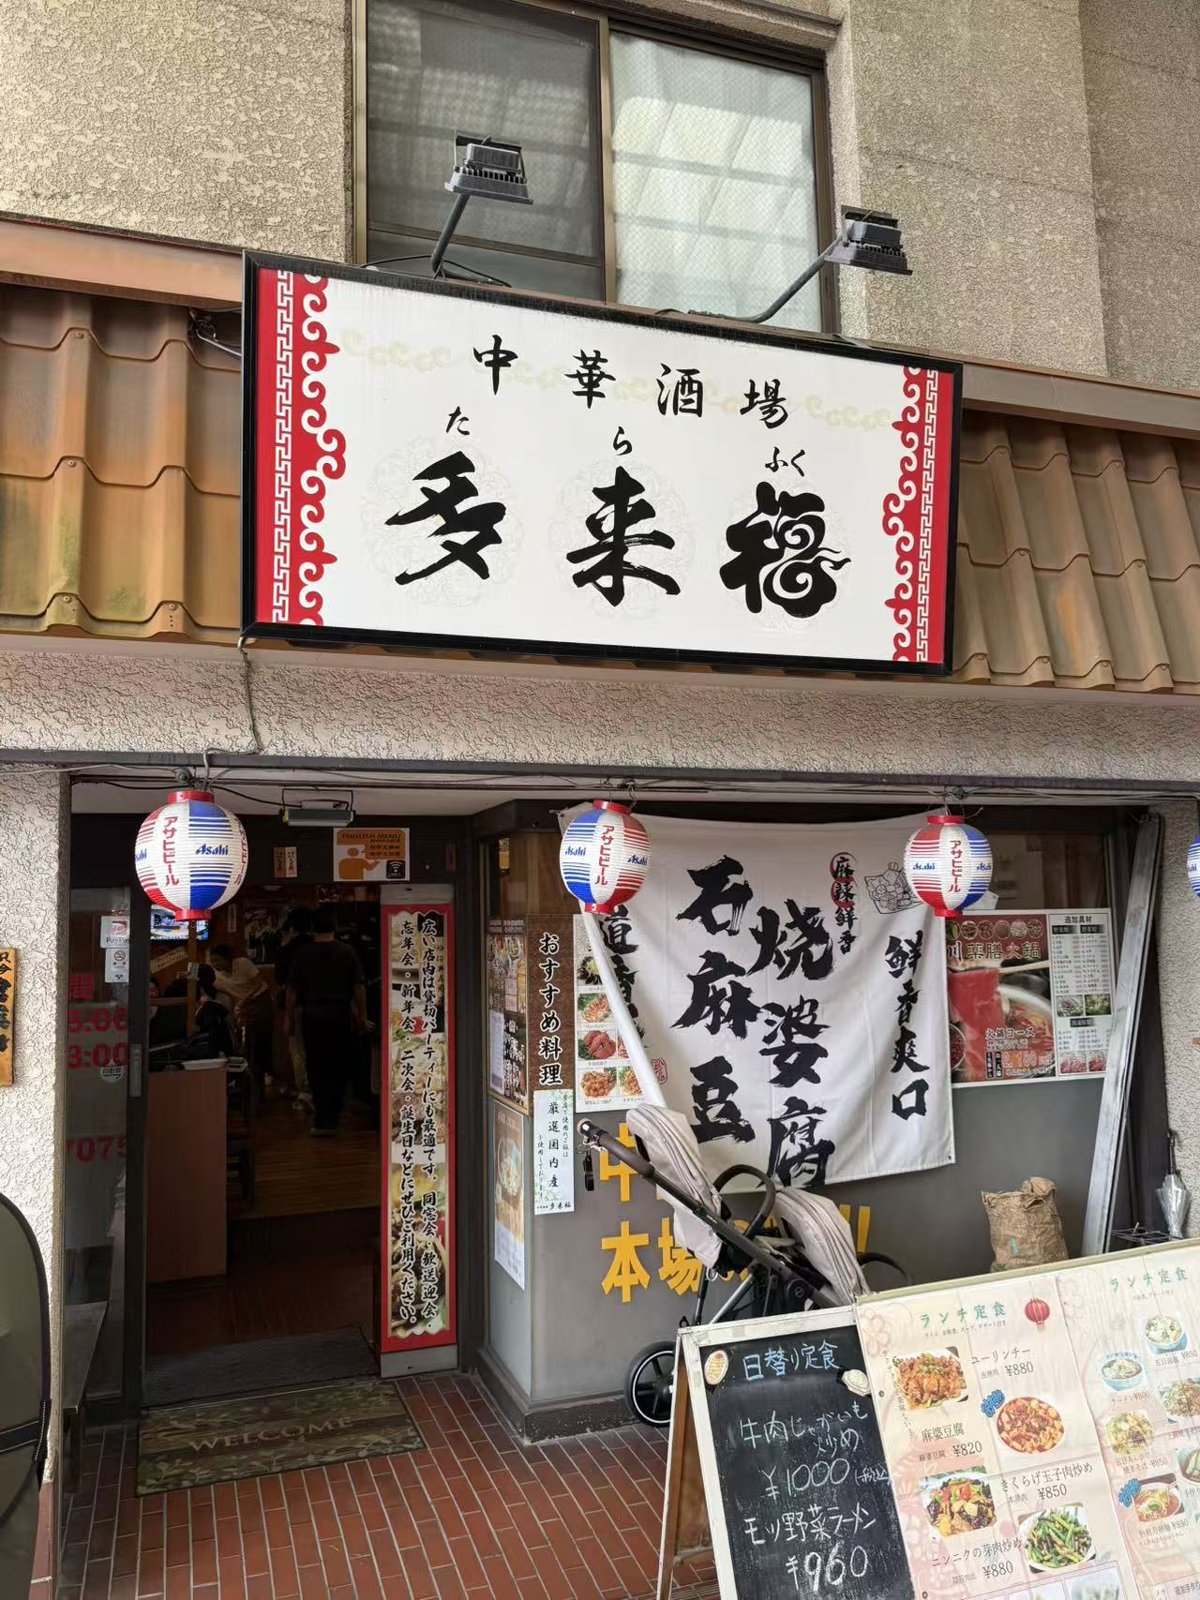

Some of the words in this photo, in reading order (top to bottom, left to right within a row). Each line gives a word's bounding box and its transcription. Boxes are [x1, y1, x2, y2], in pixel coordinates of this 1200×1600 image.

[472, 333, 790, 430] 中華酒場
[446, 406, 471, 436] た
[612, 425, 633, 456] ら
[764, 446, 808, 477] ふく
[162, 816, 180, 887] アサヒビール
[195, 843, 229, 857] Asahi
[565, 846, 587, 857] Asahi
[594, 825, 615, 887] アサヒビール
[627, 854, 648, 867] Asahi
[912, 862, 936, 871] Asahi
[948, 840, 964, 893] アサヒビール
[538, 931, 563, 1086] おすすめ料理
[547, 1101, 560, 1188] 厳選国内産
[1109, 1266, 1189, 1293] ランチ定食
[919, 1301, 1006, 1329] ランチ定食
[743, 1339, 841, 1381] 日替り定食
[970, 1347, 1031, 1366] ユーリンチー
[1005, 1361, 1034, 1377] ¥880
[189, 1416, 354, 1451] WELCOME
[740, 1400, 868, 1450] 牛肉じゃがいも
[921, 1421, 966, 1443] 麻婆豆腐
[813, 1428, 860, 1459] 炒め
[952, 1440, 983, 1459] ¥820
[762, 1457, 850, 1501] ¥1000
[1001, 1462, 1094, 1493] きくらげ玉子肉炒め
[1037, 1483, 1068, 1501] ¥850
[785, 1542, 869, 1592] ¥960
[932, 1537, 1023, 1568] ニンニクの芽肉炒め
[982, 1560, 1014, 1580] ¥880
